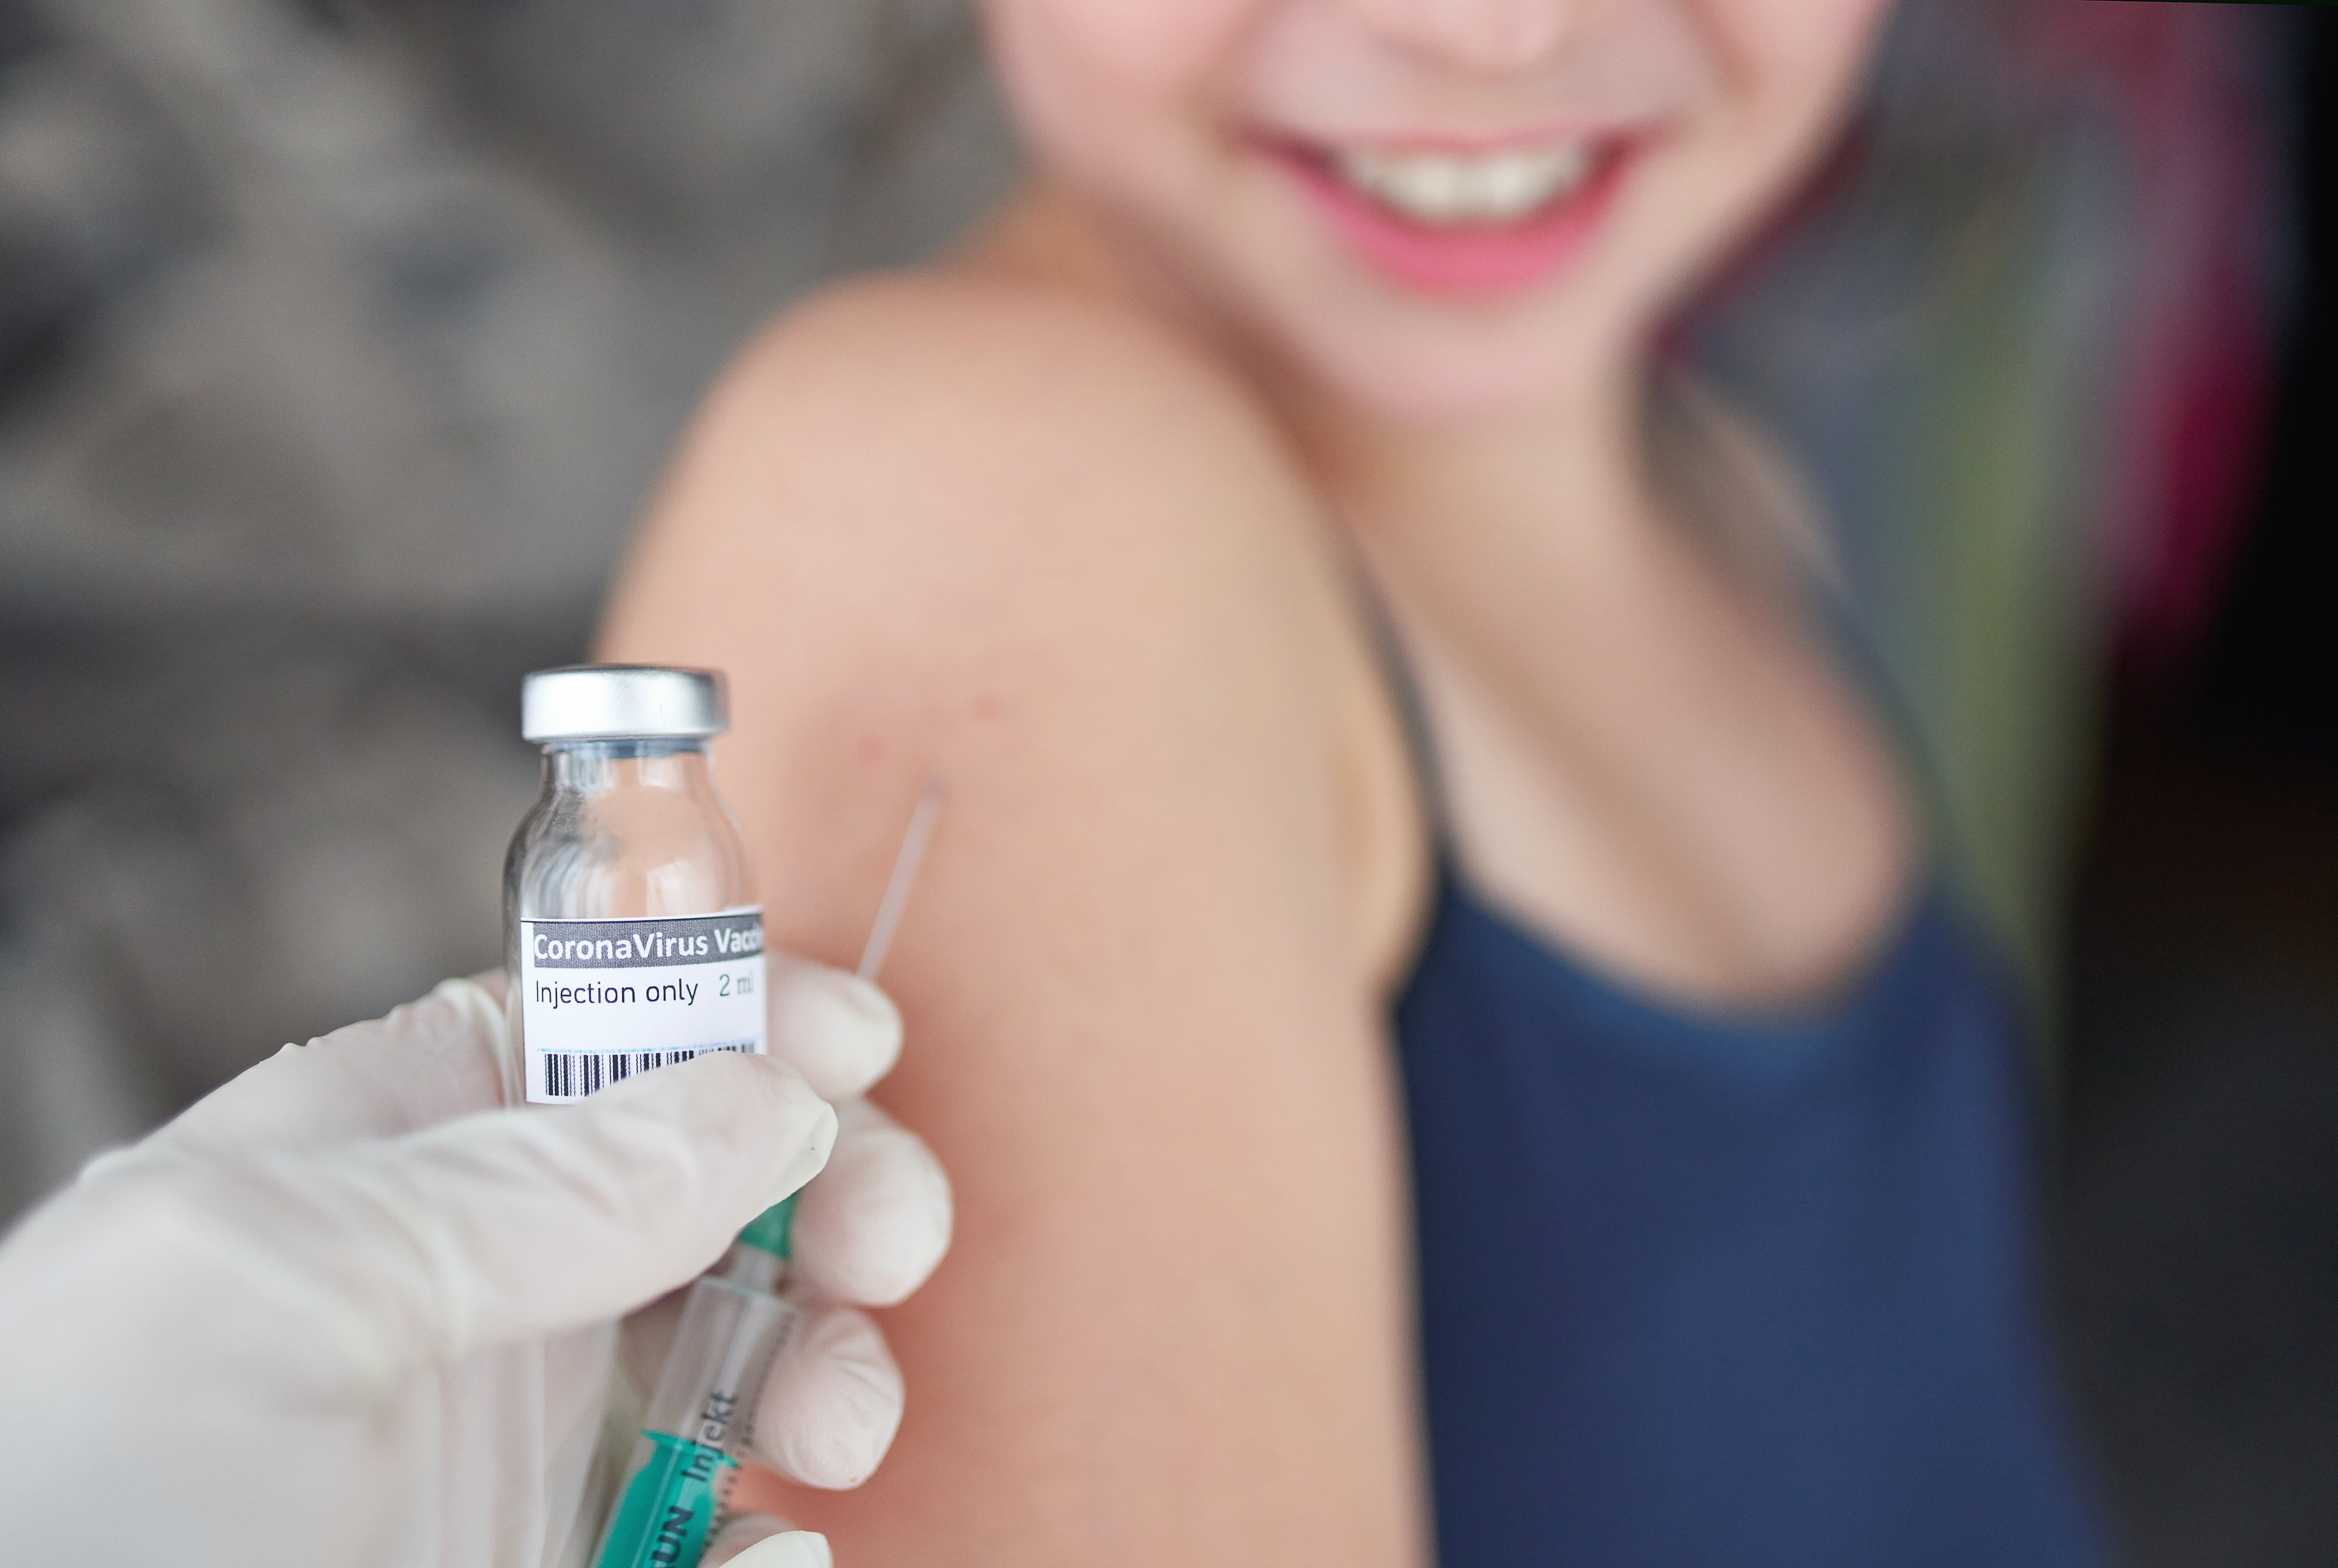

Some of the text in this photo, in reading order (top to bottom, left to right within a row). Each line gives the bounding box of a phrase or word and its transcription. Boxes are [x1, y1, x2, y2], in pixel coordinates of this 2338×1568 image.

[534, 932, 708, 960] CoronaVirus
[536, 980, 635, 1009] Injection
[646, 978, 699, 1006] only
[719, 974, 730, 996] 2
[680, 1392, 739, 1482] Injekt
[649, 1505, 694, 1568] UN
